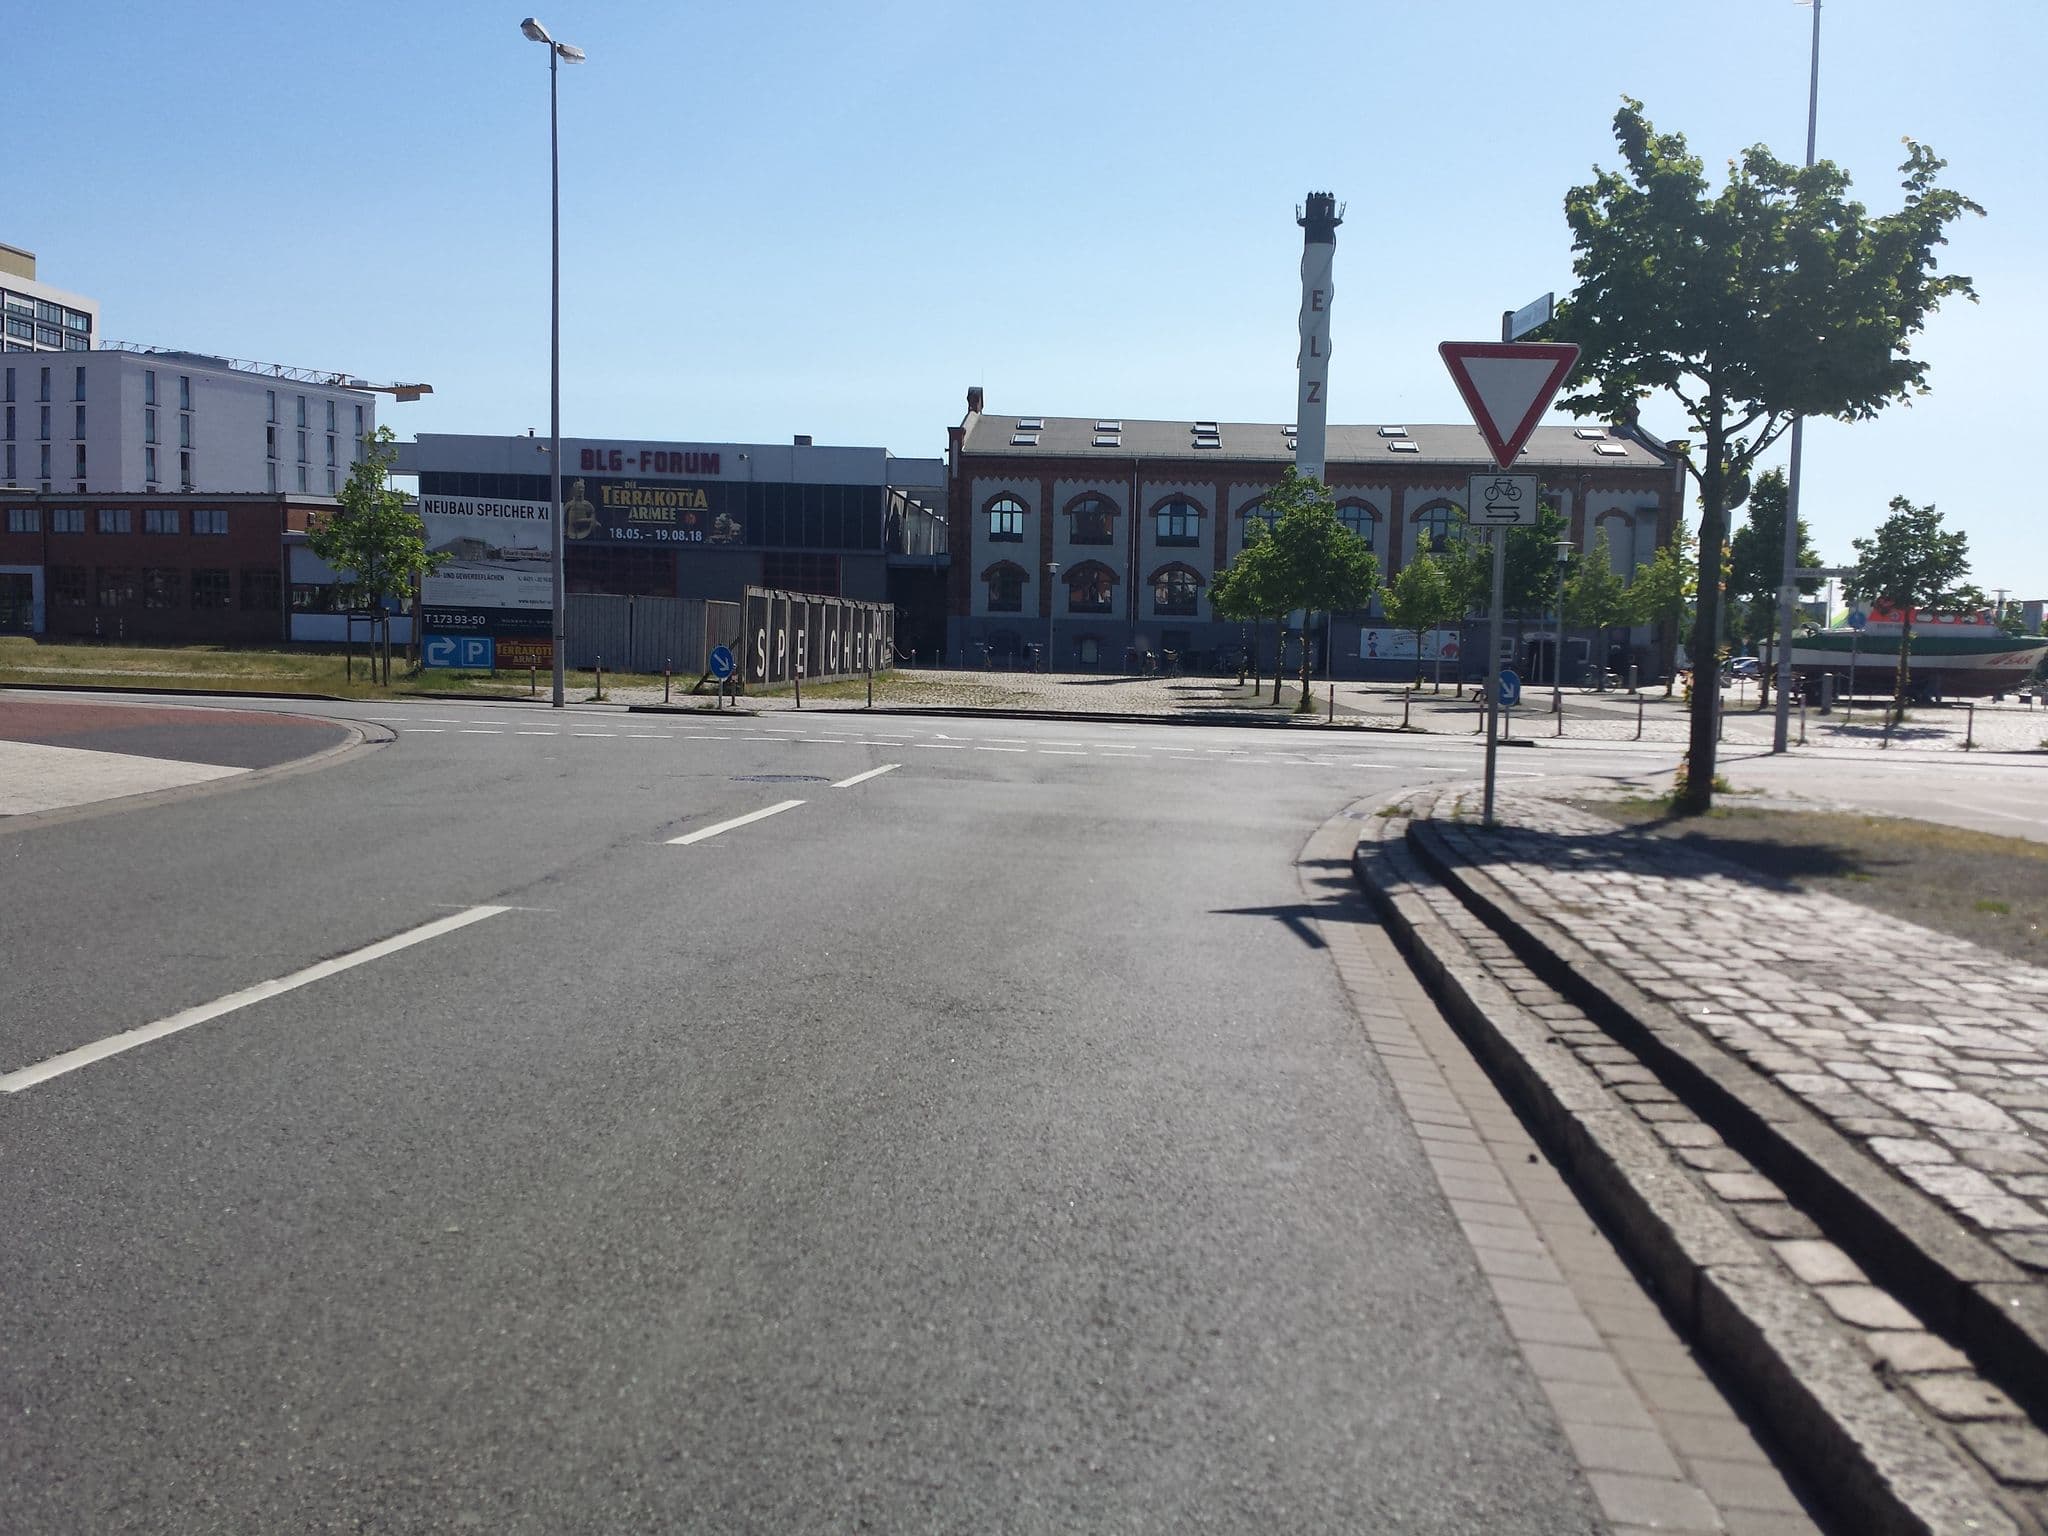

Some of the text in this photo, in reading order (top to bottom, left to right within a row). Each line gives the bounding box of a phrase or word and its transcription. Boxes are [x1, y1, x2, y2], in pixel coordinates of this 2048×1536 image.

[601, 486, 708, 508] TERRAKOTTA
[424, 500, 549, 520] NEUBAU SPEICHER XI
[628, 507, 676, 521] ARMEE
[610, 528, 643, 540] 18.05.
[655, 529, 702, 542] 19.08.18
[468, 642, 483, 662] P
[496, 644, 552, 655] TERRAKOTT
[756, 628, 874, 679] SPEICHER
